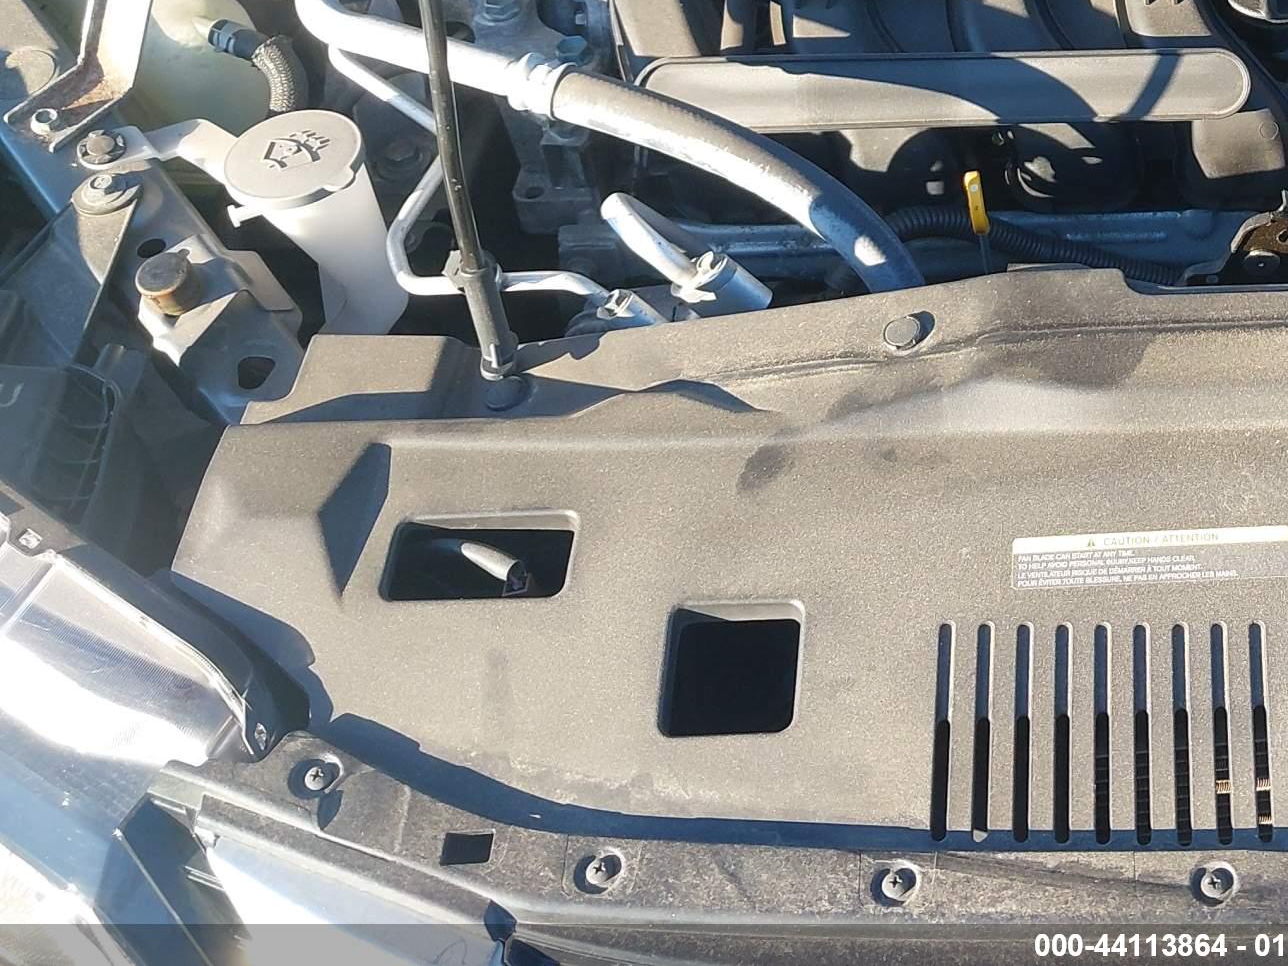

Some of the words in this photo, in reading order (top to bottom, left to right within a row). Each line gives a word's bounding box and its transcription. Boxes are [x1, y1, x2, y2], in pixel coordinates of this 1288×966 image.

[1103, 536, 1150, 547] CAUTION
[1162, 533, 1219, 543] ATTENTION
[1029, 561, 1047, 571] HELP
